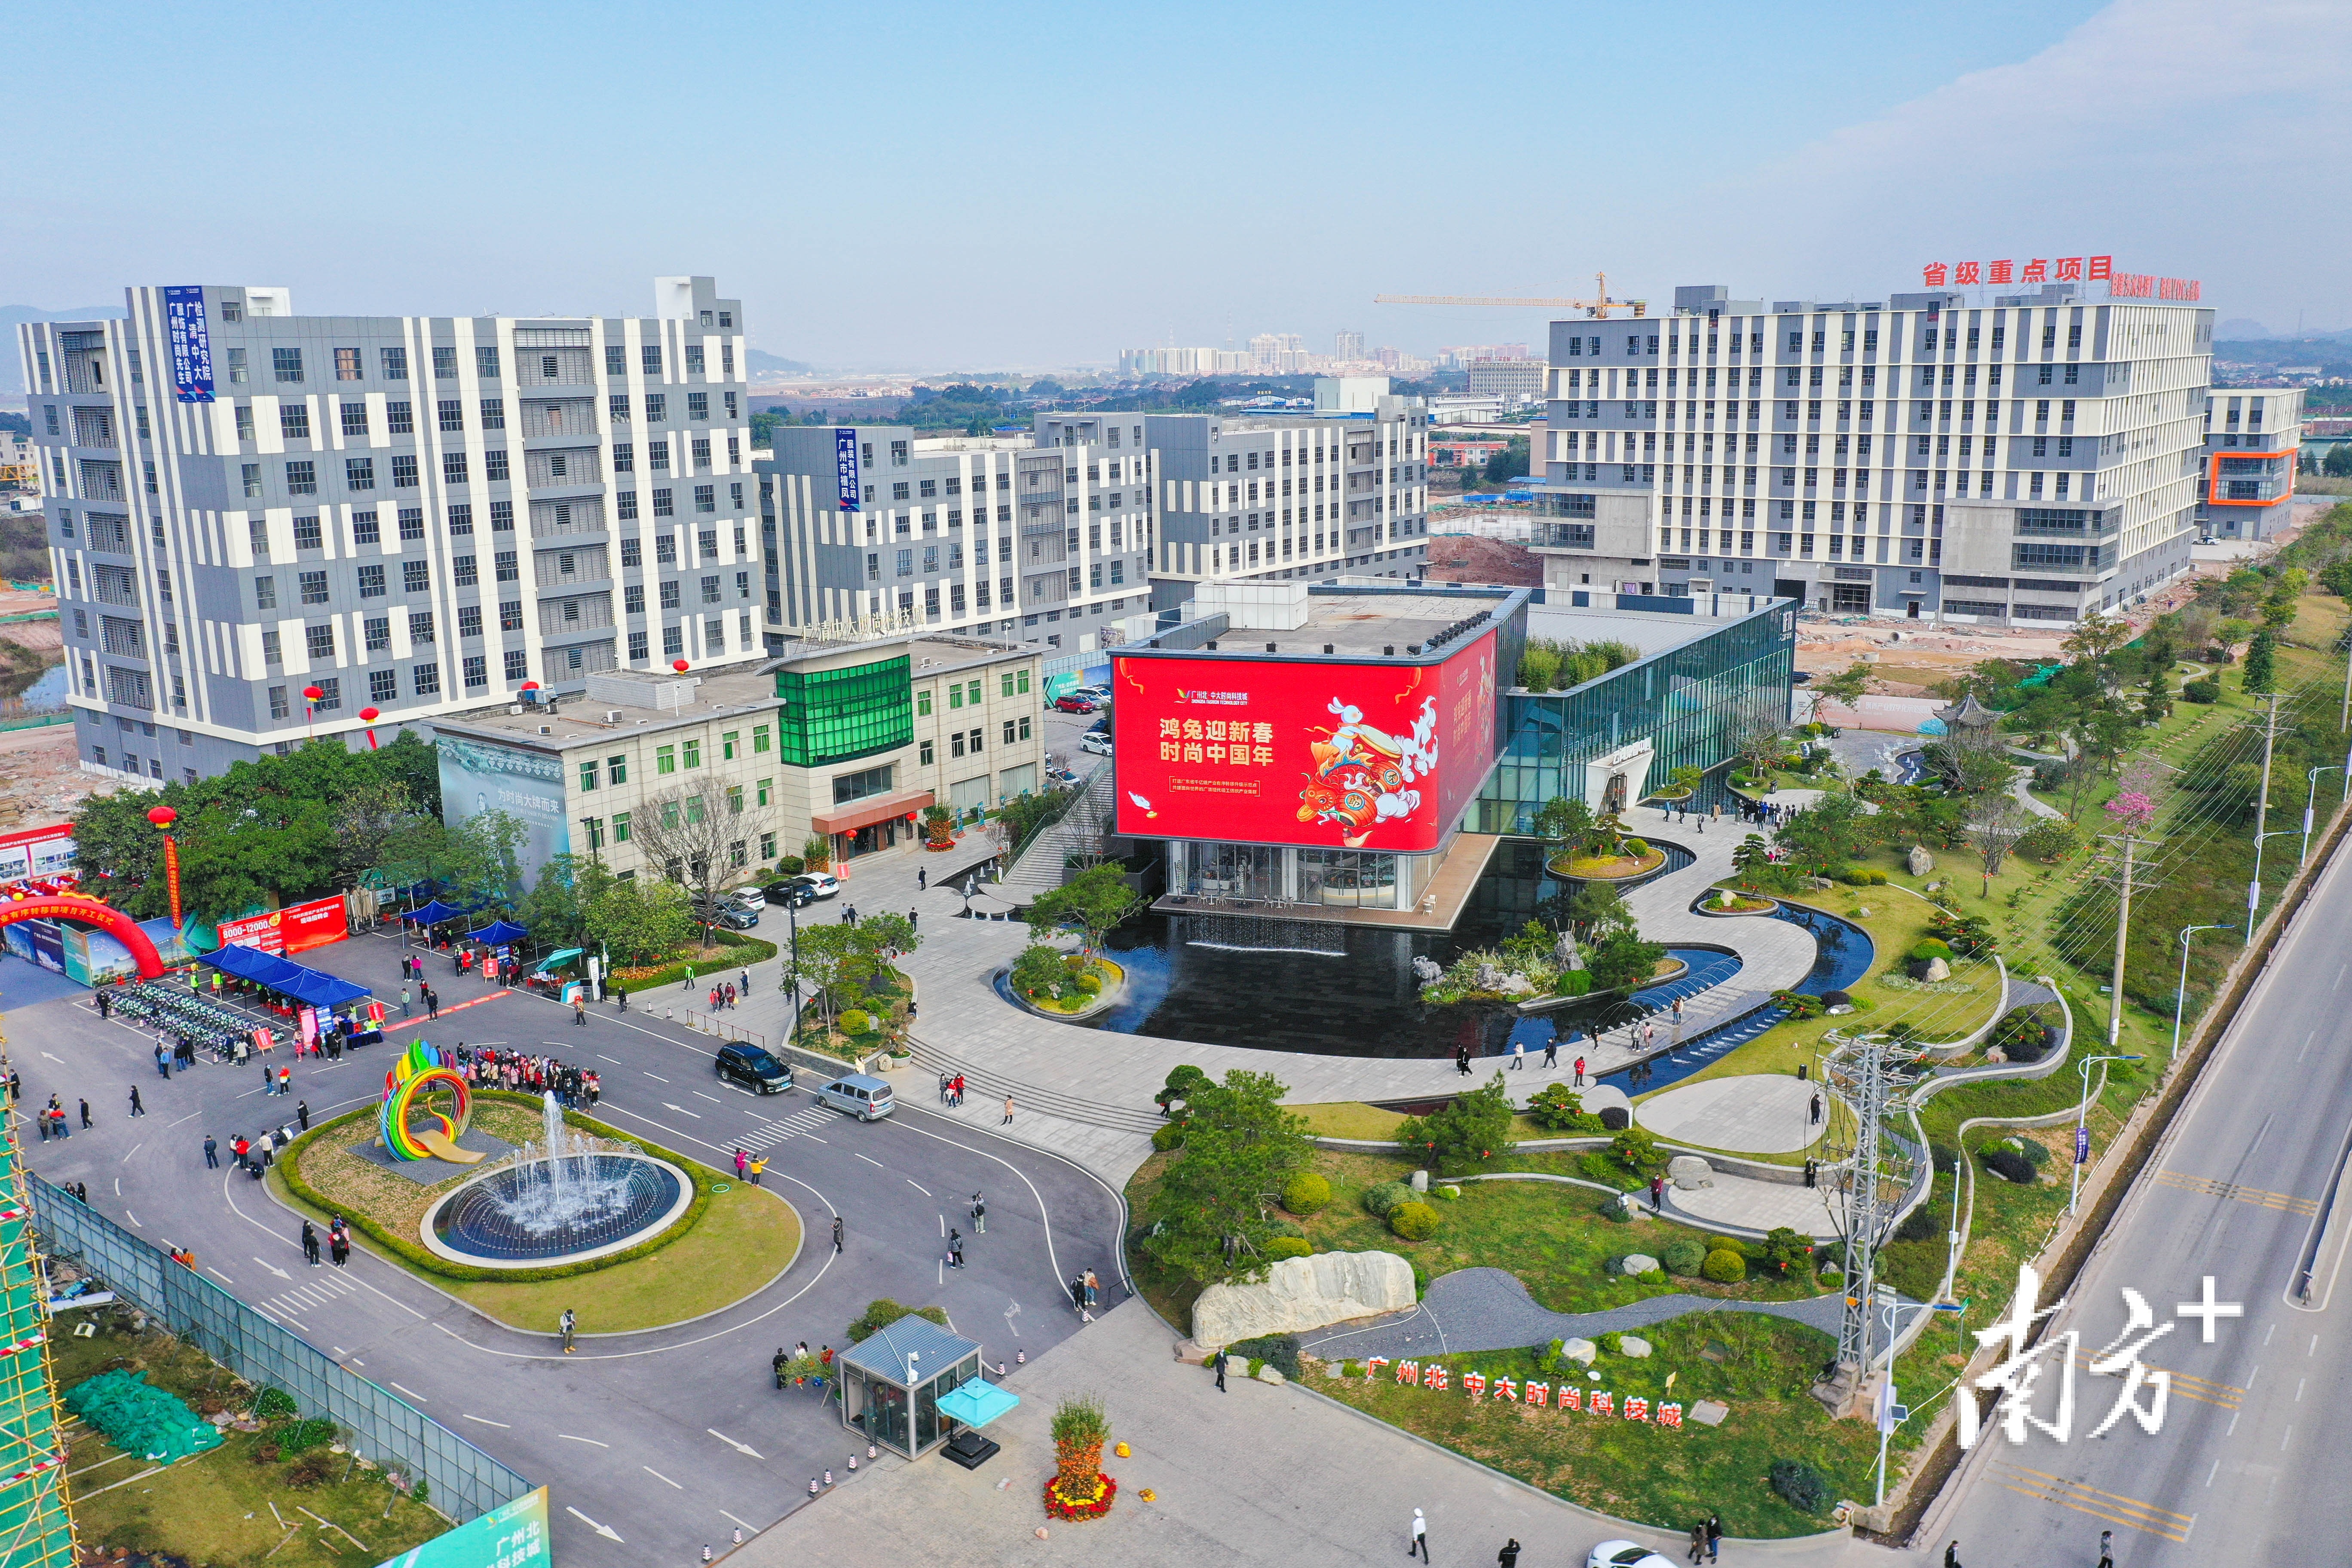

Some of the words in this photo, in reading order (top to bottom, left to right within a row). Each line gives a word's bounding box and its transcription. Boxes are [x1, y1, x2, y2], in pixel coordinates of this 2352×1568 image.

[1923, 255, 2112, 287] 省级重点项目
[169, 302, 185, 384] 广州时尚先生
[177, 303, 192, 384] 服饰有限公司
[187, 302, 202, 380] 广清中大
[195, 301, 211, 381] 检测研究院
[839, 438, 849, 498] 广州市禧凤
[847, 439, 856, 499] 服装有限公司
[802, 605, 925, 643] 广清中大时尚科技城
[1160, 718, 1274, 744] 鸿兔迎新春
[1160, 741, 1274, 766] 时尚中国年
[498, 788, 560, 814] 为时尚大牌而来
[1366, 1356, 1449, 1390] 广州北
[1463, 1371, 1683, 1428] 中大时尚科技城
[496, 1520, 540, 1557] 广州北
